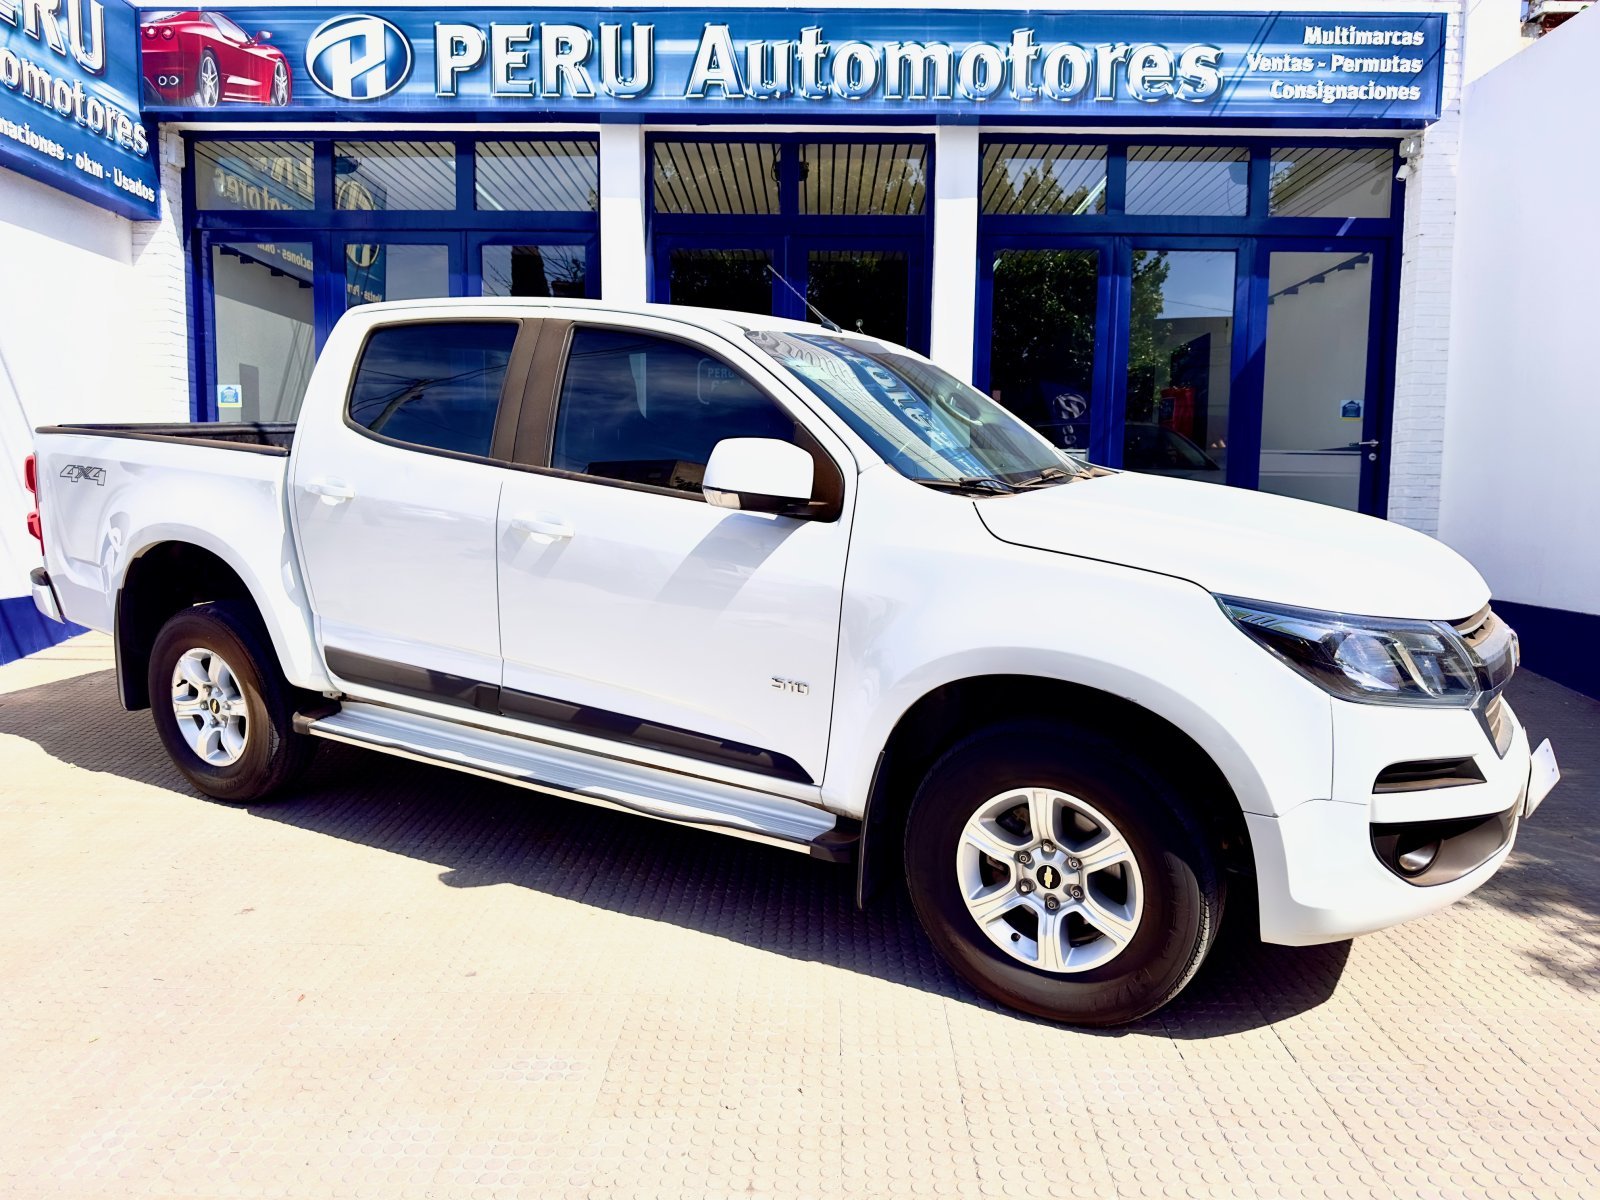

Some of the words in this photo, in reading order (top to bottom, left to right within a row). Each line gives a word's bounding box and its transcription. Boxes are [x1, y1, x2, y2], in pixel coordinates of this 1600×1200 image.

[1303, 25, 1424, 46] Multimarcas
[434, 22, 656, 99] PERU
[684, 22, 1224, 102] Automotores
[1247, 52, 1315, 73] Ventas
[1330, 53, 1423, 73] Permutas
[1269, 79, 1421, 104] Consignaciones
[113, 166, 155, 203] Usados
[771, 677, 809, 696] S10
